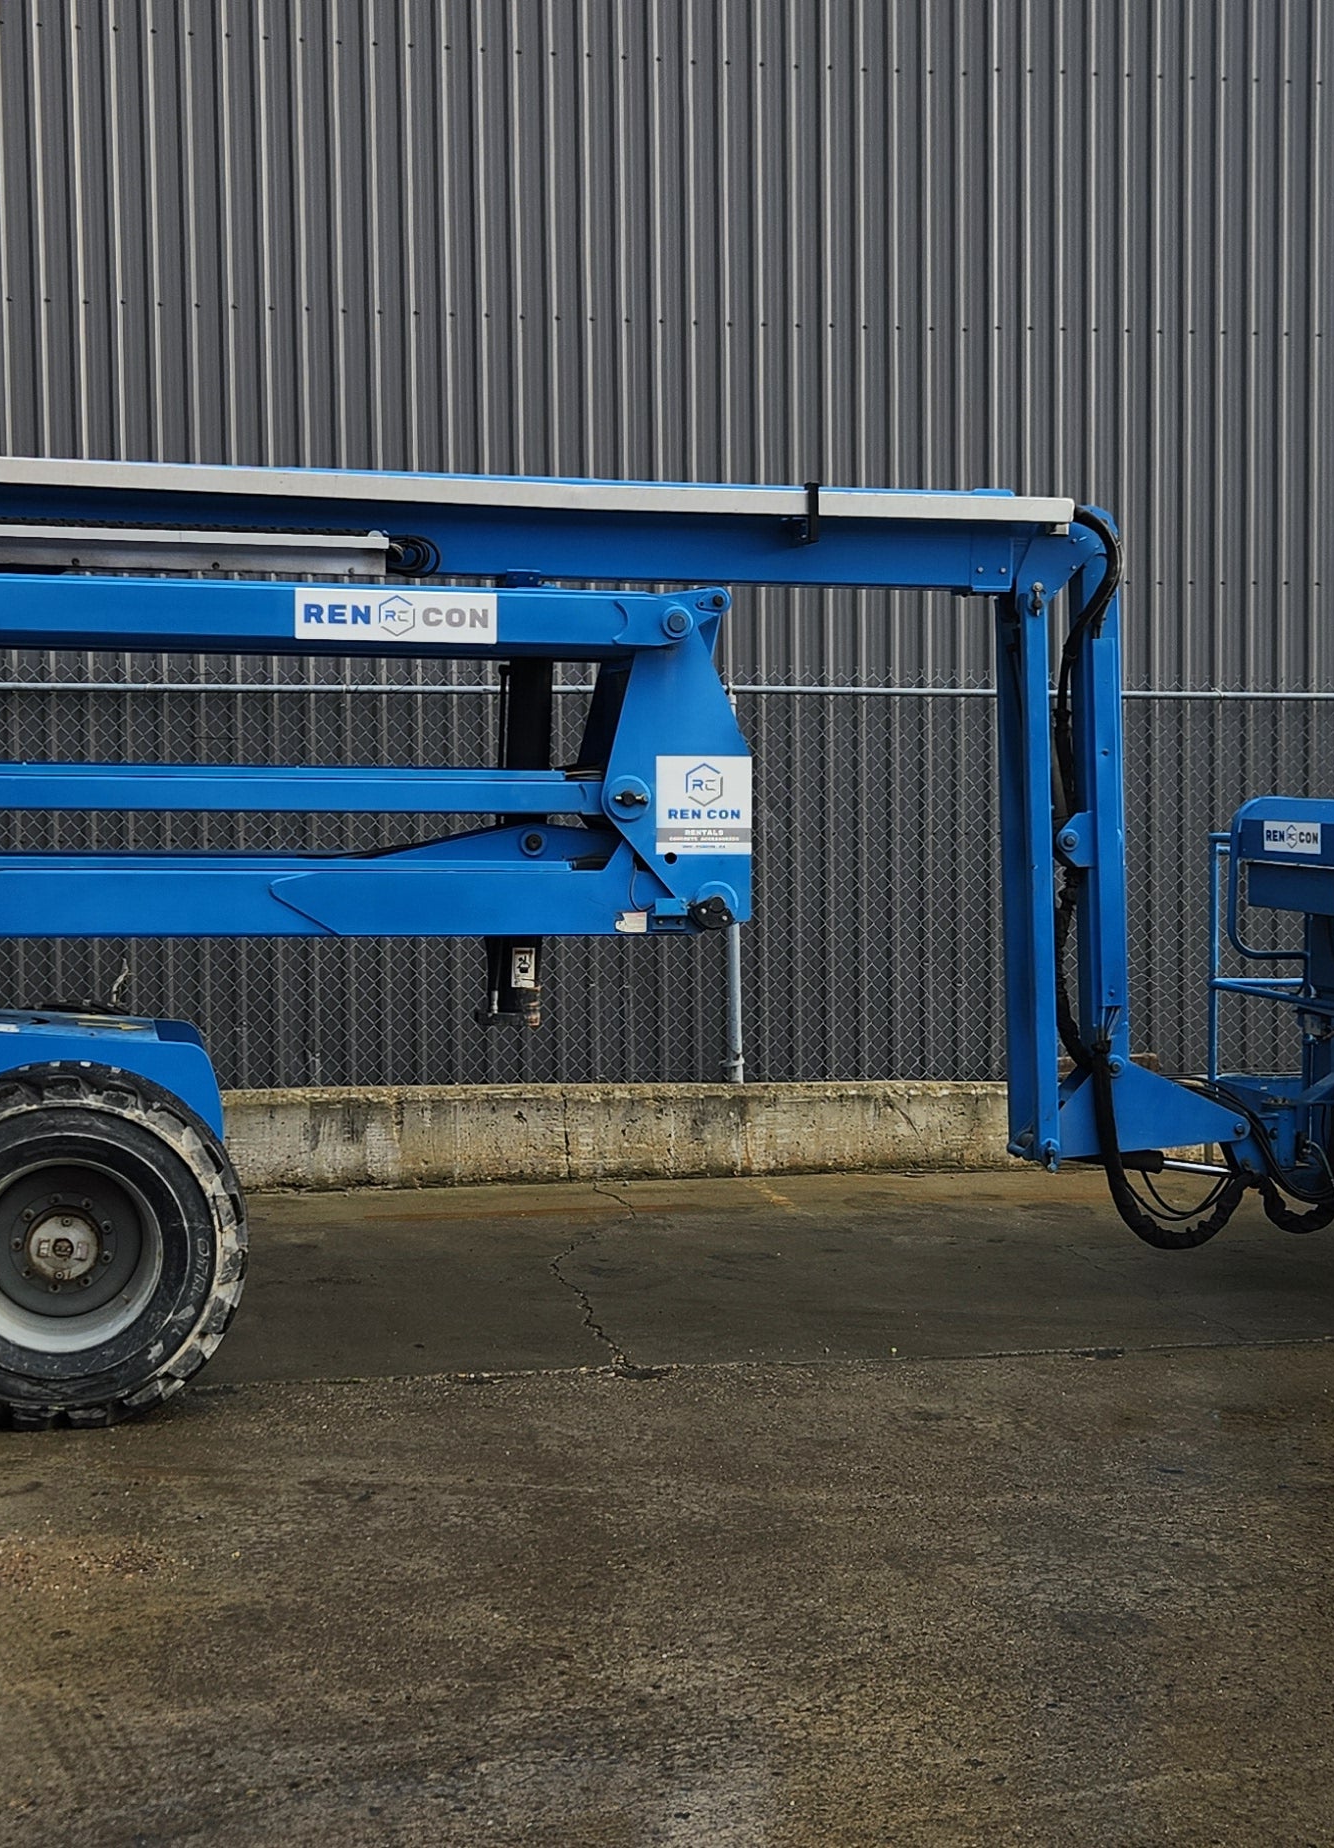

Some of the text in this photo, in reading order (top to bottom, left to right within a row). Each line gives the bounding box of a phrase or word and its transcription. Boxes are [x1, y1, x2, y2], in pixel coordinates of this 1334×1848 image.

[303, 603, 371, 625] REN
[422, 607, 489, 628] CON
[668, 809, 741, 819] REN CON
[1266, 830, 1285, 842] REN
[1298, 831, 1318, 844] CON
